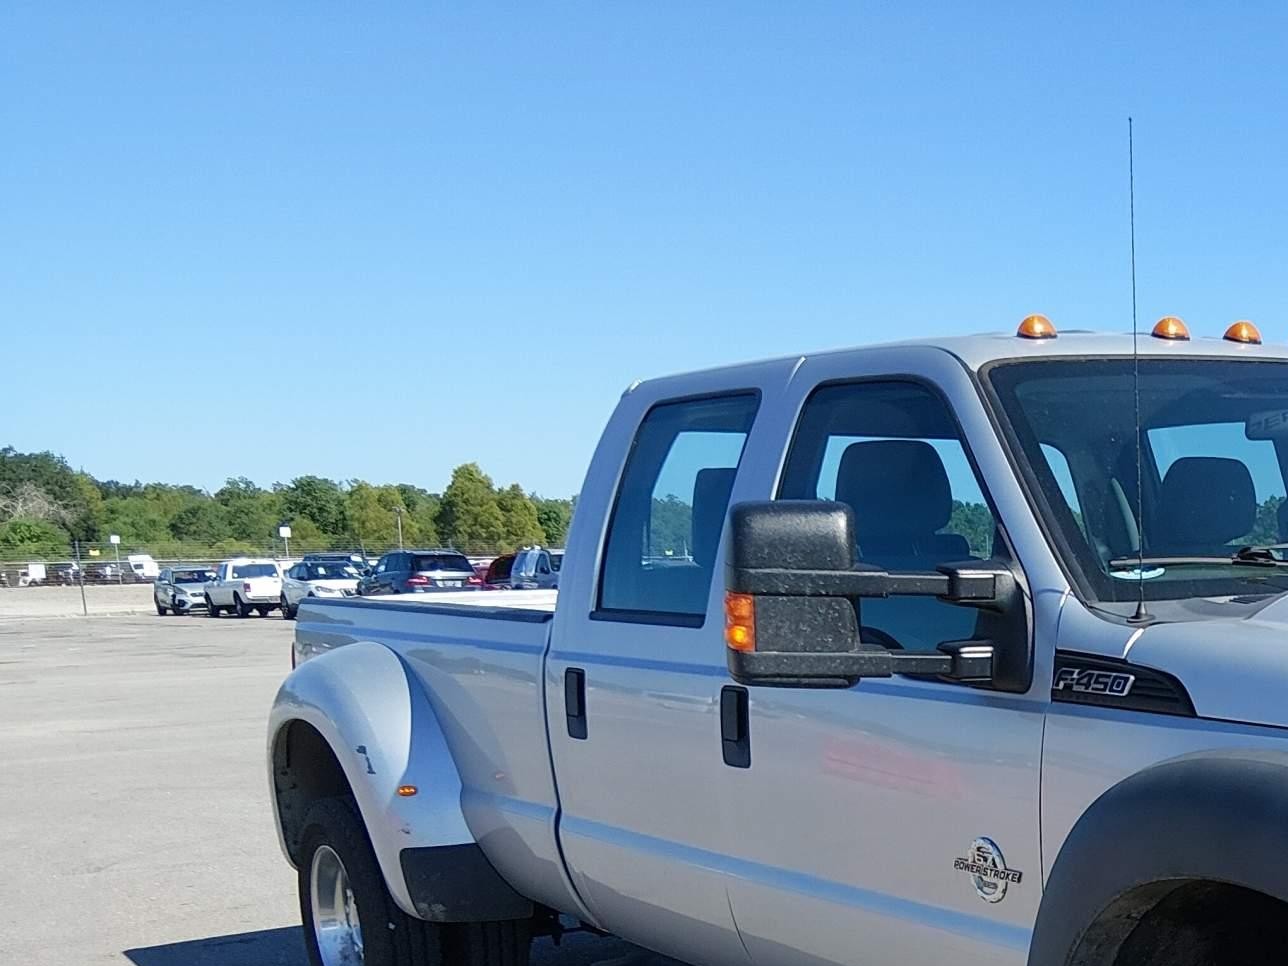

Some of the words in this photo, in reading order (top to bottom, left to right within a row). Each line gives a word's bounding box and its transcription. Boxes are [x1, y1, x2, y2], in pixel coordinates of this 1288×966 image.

[1053, 667, 1136, 697] F-450
[953, 860, 982, 873] POWER
[982, 867, 1018, 883] STROKE
